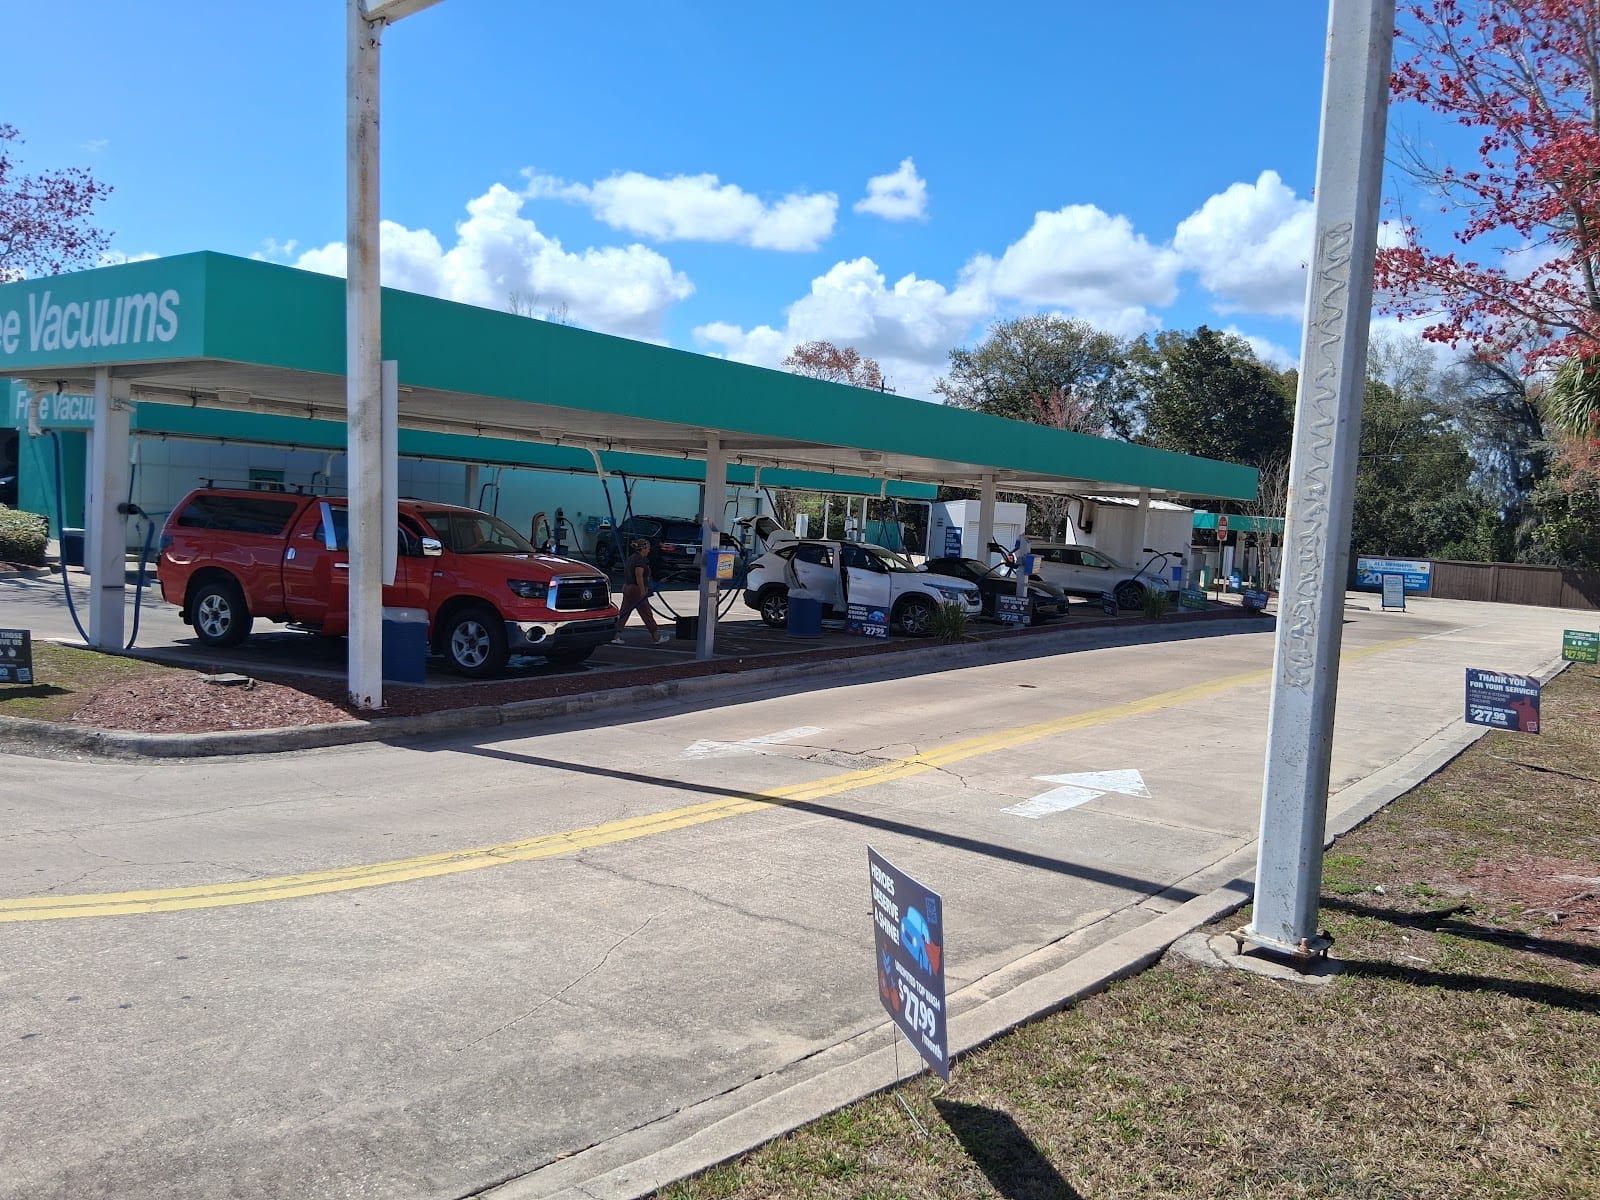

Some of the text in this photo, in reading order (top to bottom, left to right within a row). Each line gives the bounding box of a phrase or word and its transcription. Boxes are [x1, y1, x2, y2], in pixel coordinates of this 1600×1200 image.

[28, 289, 180, 352] Vacuums
[15, 390, 97, 420] Fre Vacuu
[1469, 680, 1538, 697] FOR YOUR SERVICE!
[1478, 673, 1527, 687] THANK YOU
[1470, 708, 1506, 723] $27.99
[870, 860, 895, 897] HEROES
[872, 882, 900, 923] DESERVE
[874, 905, 900, 946] A SHINE!
[898, 978, 936, 1038] $27.99
[922, 1031, 943, 1062] /month
